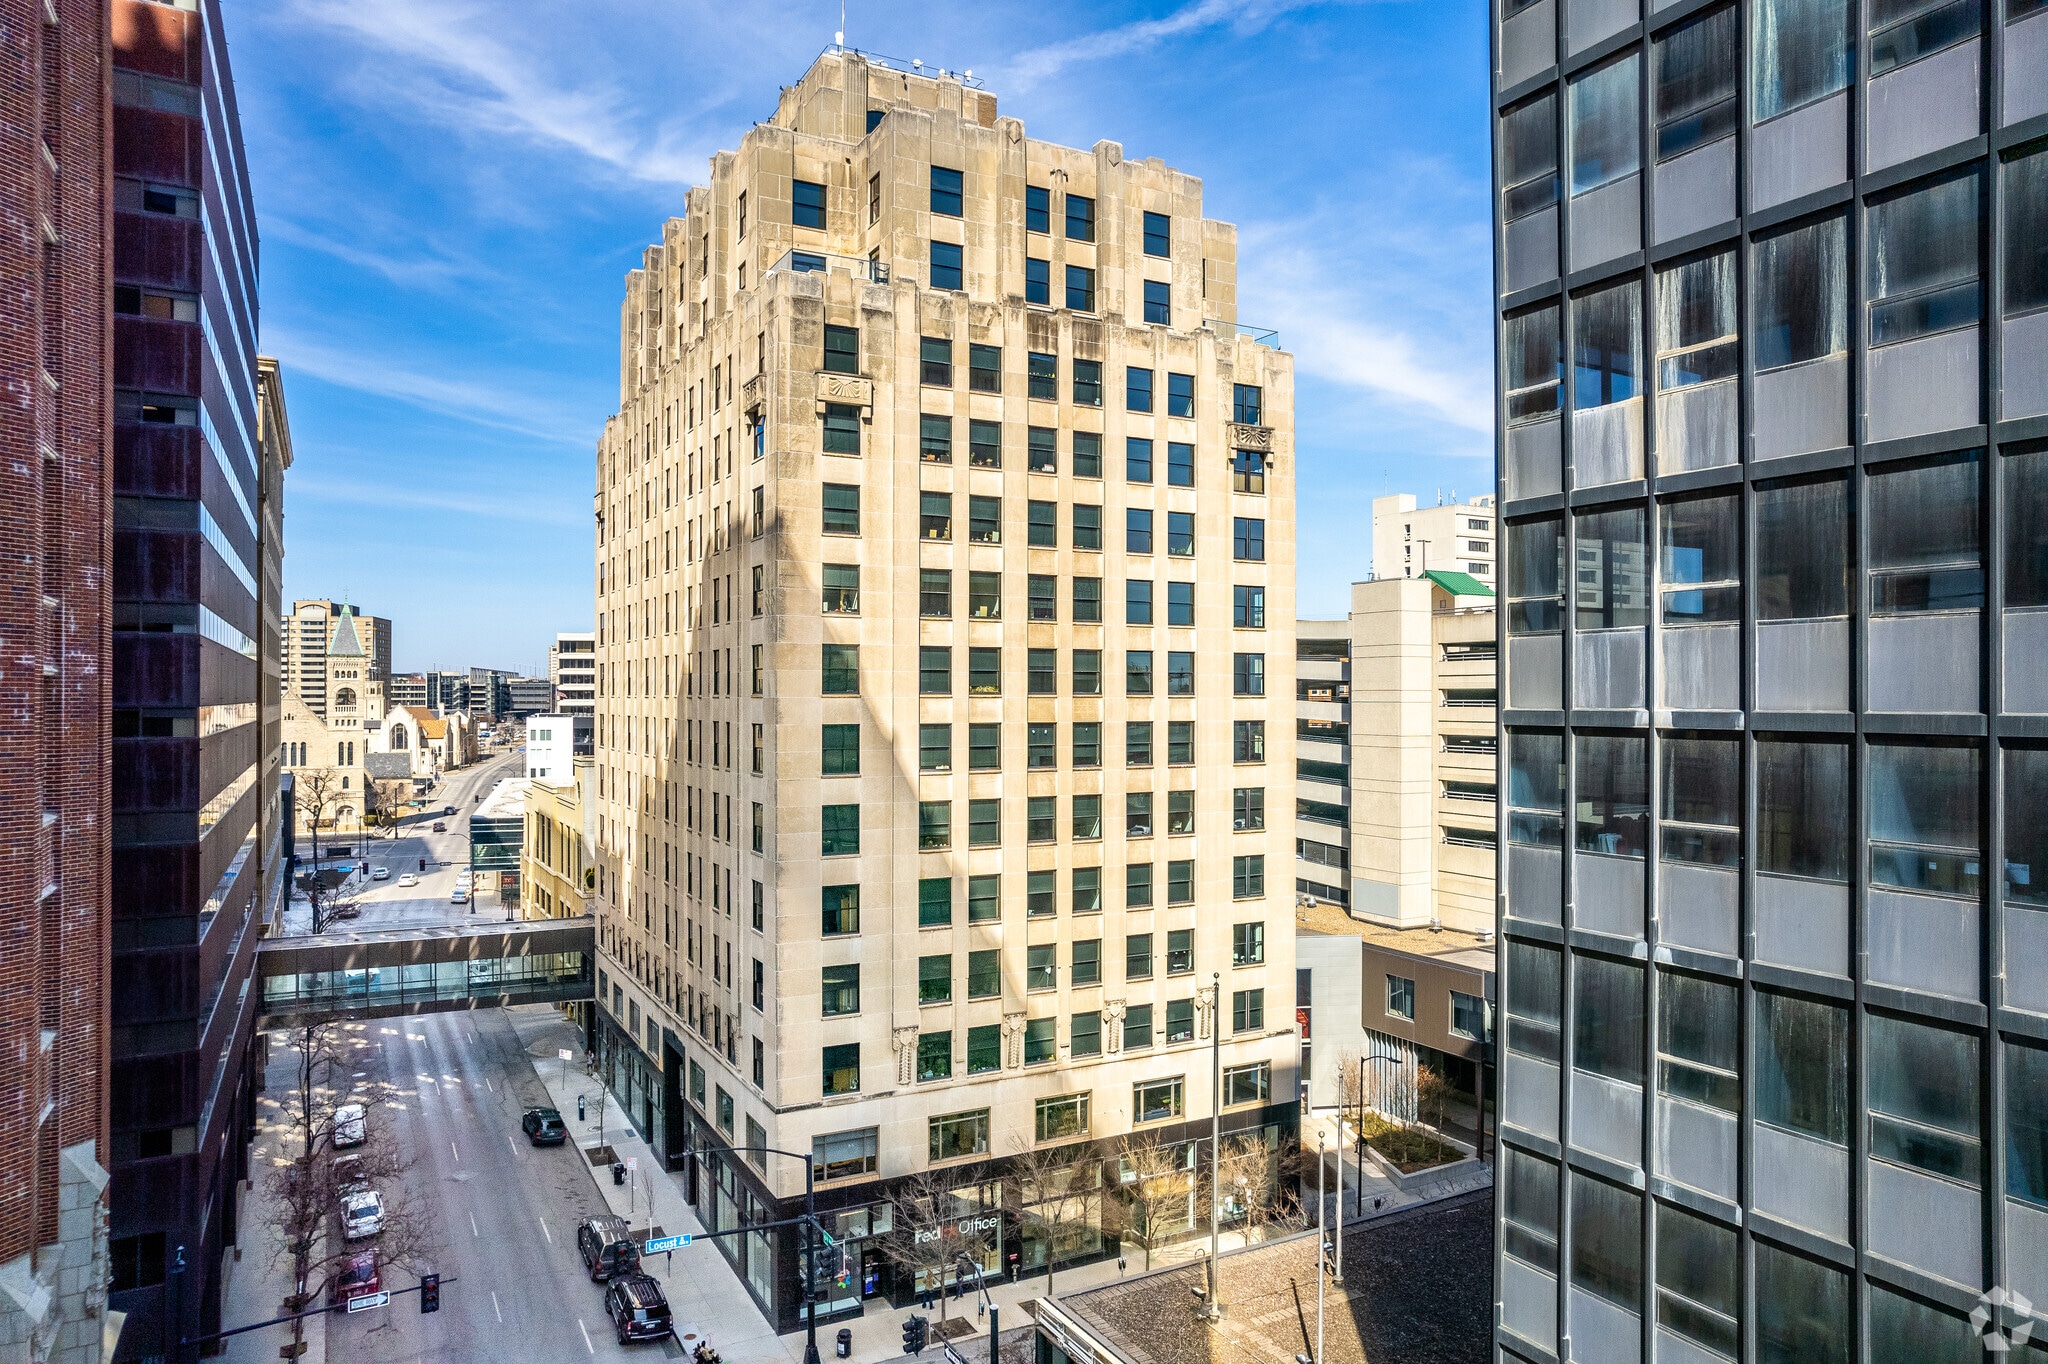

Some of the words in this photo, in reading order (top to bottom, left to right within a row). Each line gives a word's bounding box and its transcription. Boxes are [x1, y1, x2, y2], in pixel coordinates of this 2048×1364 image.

[958, 1217, 997, 1234] Office
[649, 1237, 677, 1251] Locust
[352, 1300, 365, 1308] ONE
[365, 1297, 378, 1305] WAY
